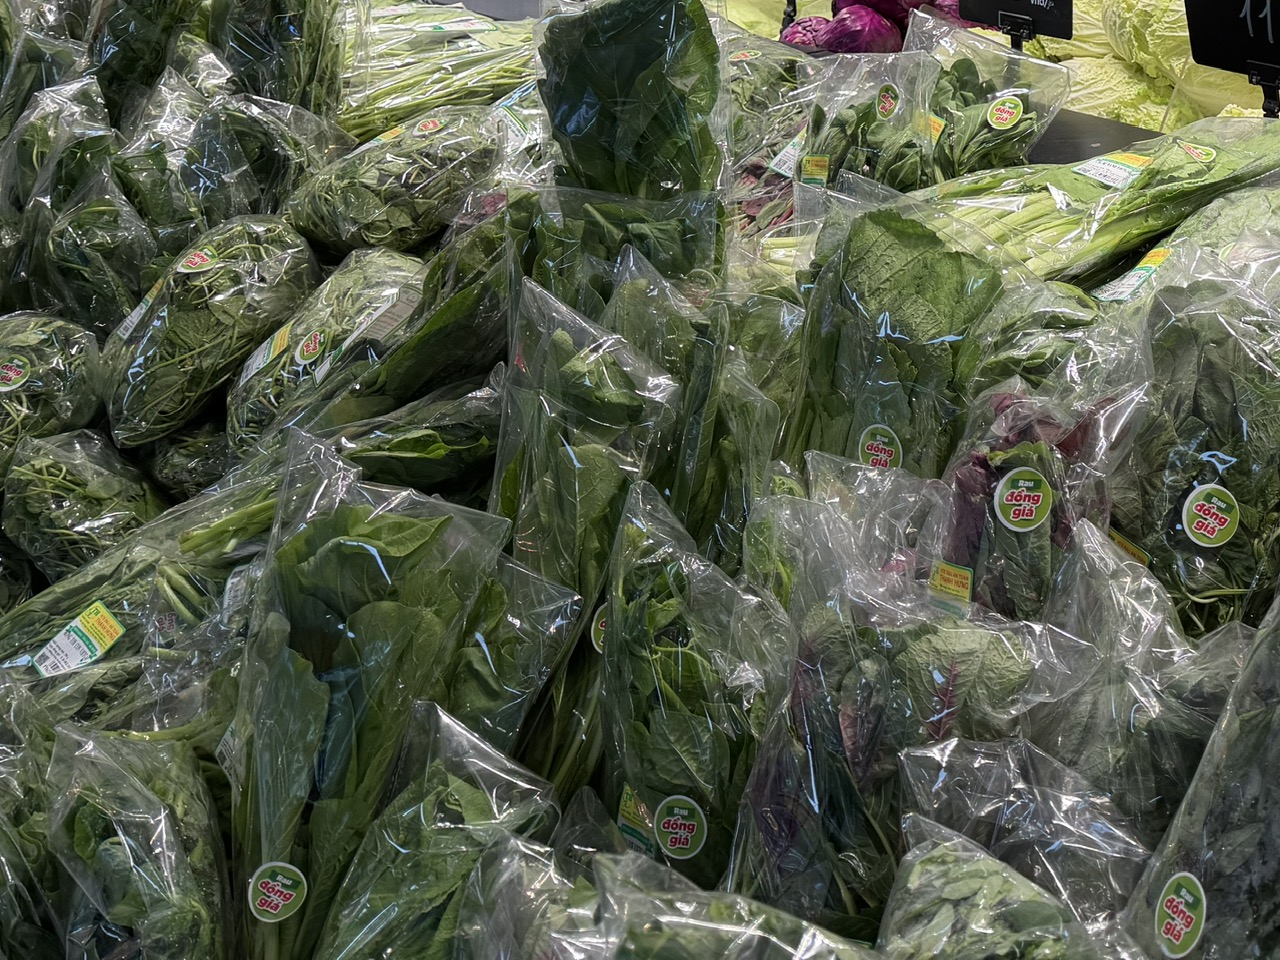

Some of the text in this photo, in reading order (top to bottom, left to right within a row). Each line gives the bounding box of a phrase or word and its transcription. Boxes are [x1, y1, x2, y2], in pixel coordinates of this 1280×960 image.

[994, 106, 1015, 118] đồng
[865, 442, 894, 459] đồng
[1018, 480, 1034, 488] Rau
[1004, 488, 1041, 506] đồng
[1211, 496, 1227, 509] Rau
[1011, 505, 1035, 521] giá
[1193, 501, 1230, 528] đồng
[1193, 519, 1217, 538] giá
[674, 807, 689, 816] Rau
[661, 816, 697, 836] đồng
[668, 833, 691, 849] giá
[275, 874, 293, 887] Rau
[259, 879, 296, 902] đồng
[256, 896, 282, 914] giá
[1163, 894, 1196, 930] đồng
[1161, 918, 1184, 946] giá
